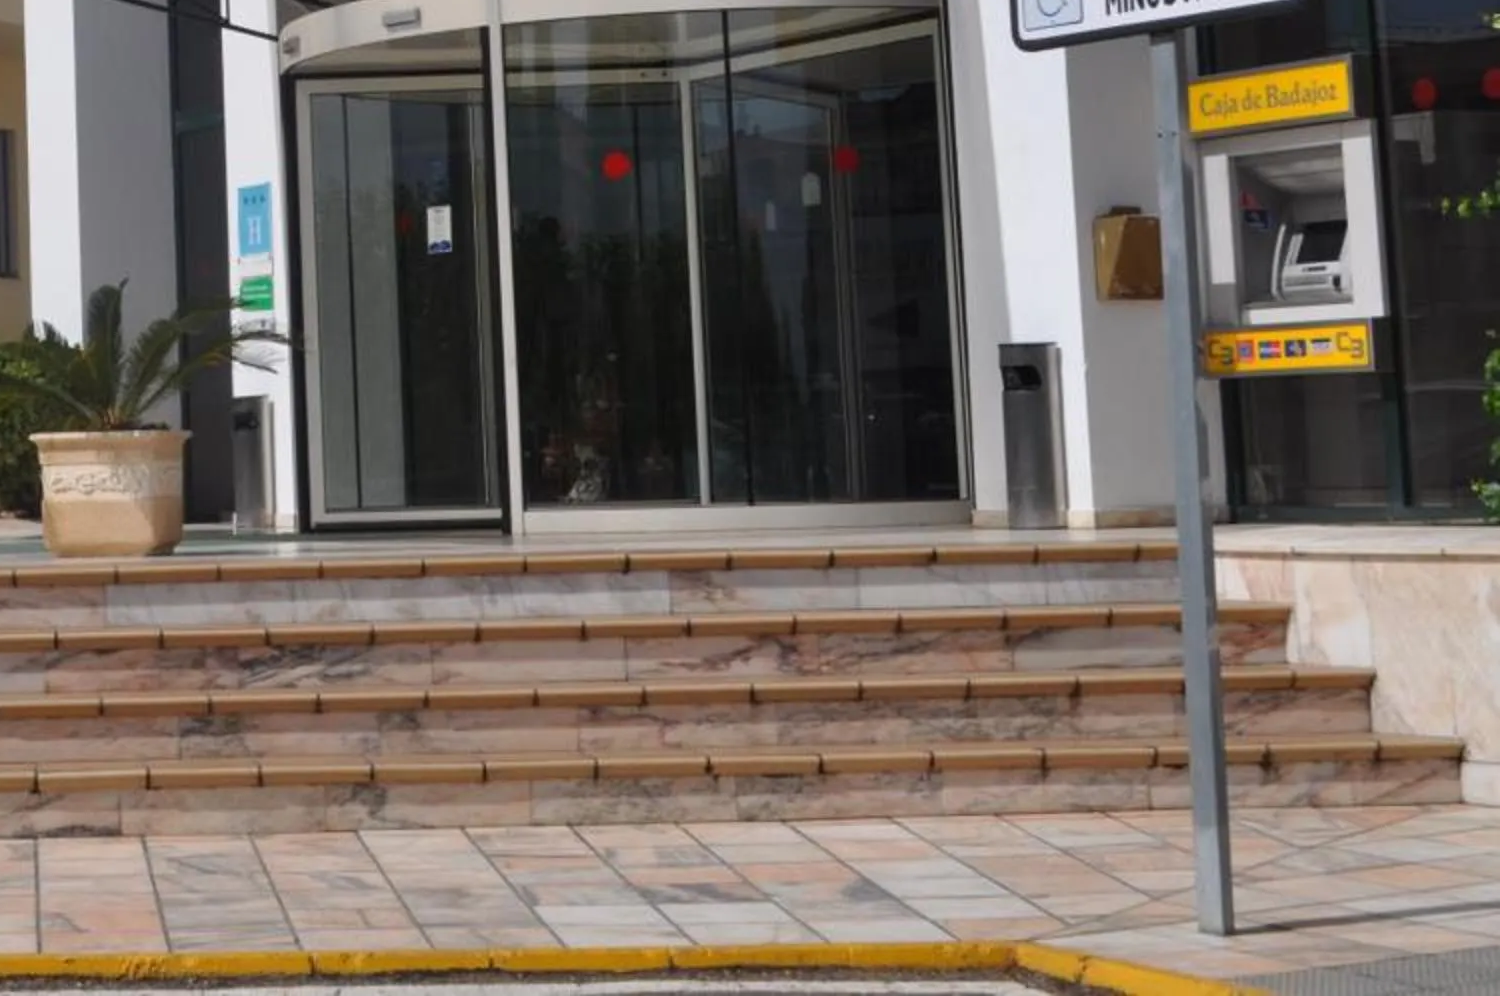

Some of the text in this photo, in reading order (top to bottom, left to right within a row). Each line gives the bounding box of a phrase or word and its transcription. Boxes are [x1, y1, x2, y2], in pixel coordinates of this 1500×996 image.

[1200, 80, 1339, 119] Caja de Badajoz
